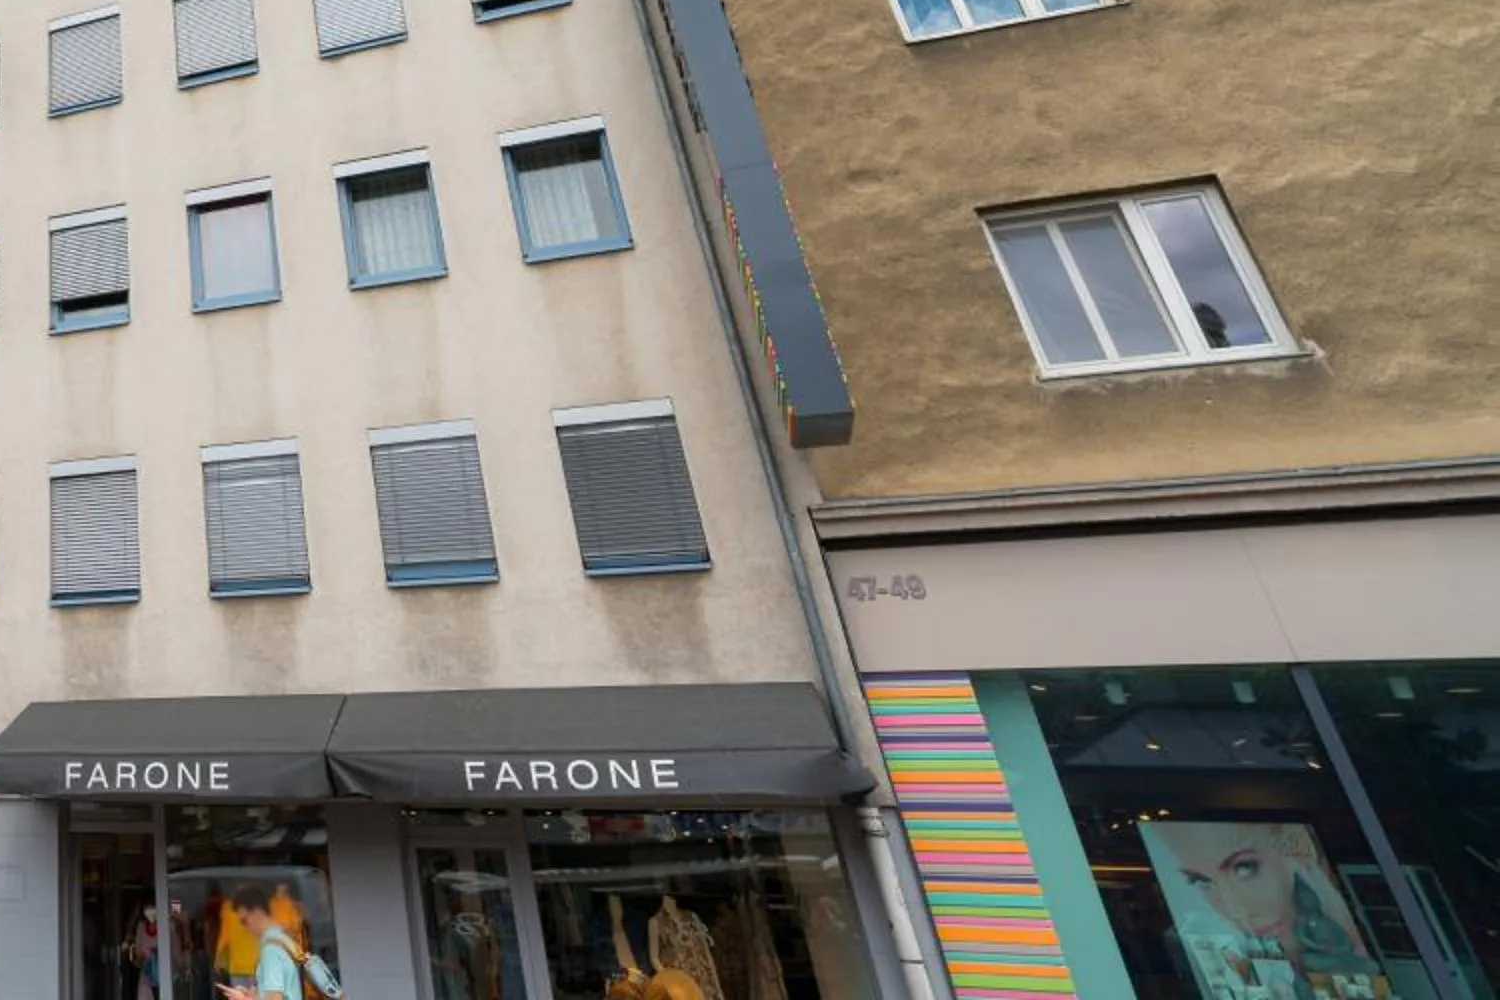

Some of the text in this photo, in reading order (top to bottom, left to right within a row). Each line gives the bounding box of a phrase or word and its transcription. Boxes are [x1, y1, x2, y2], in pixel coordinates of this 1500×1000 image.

[848, 574, 927, 601] 47-49
[65, 761, 229, 790] FARONE
[465, 759, 679, 790] FARONE
